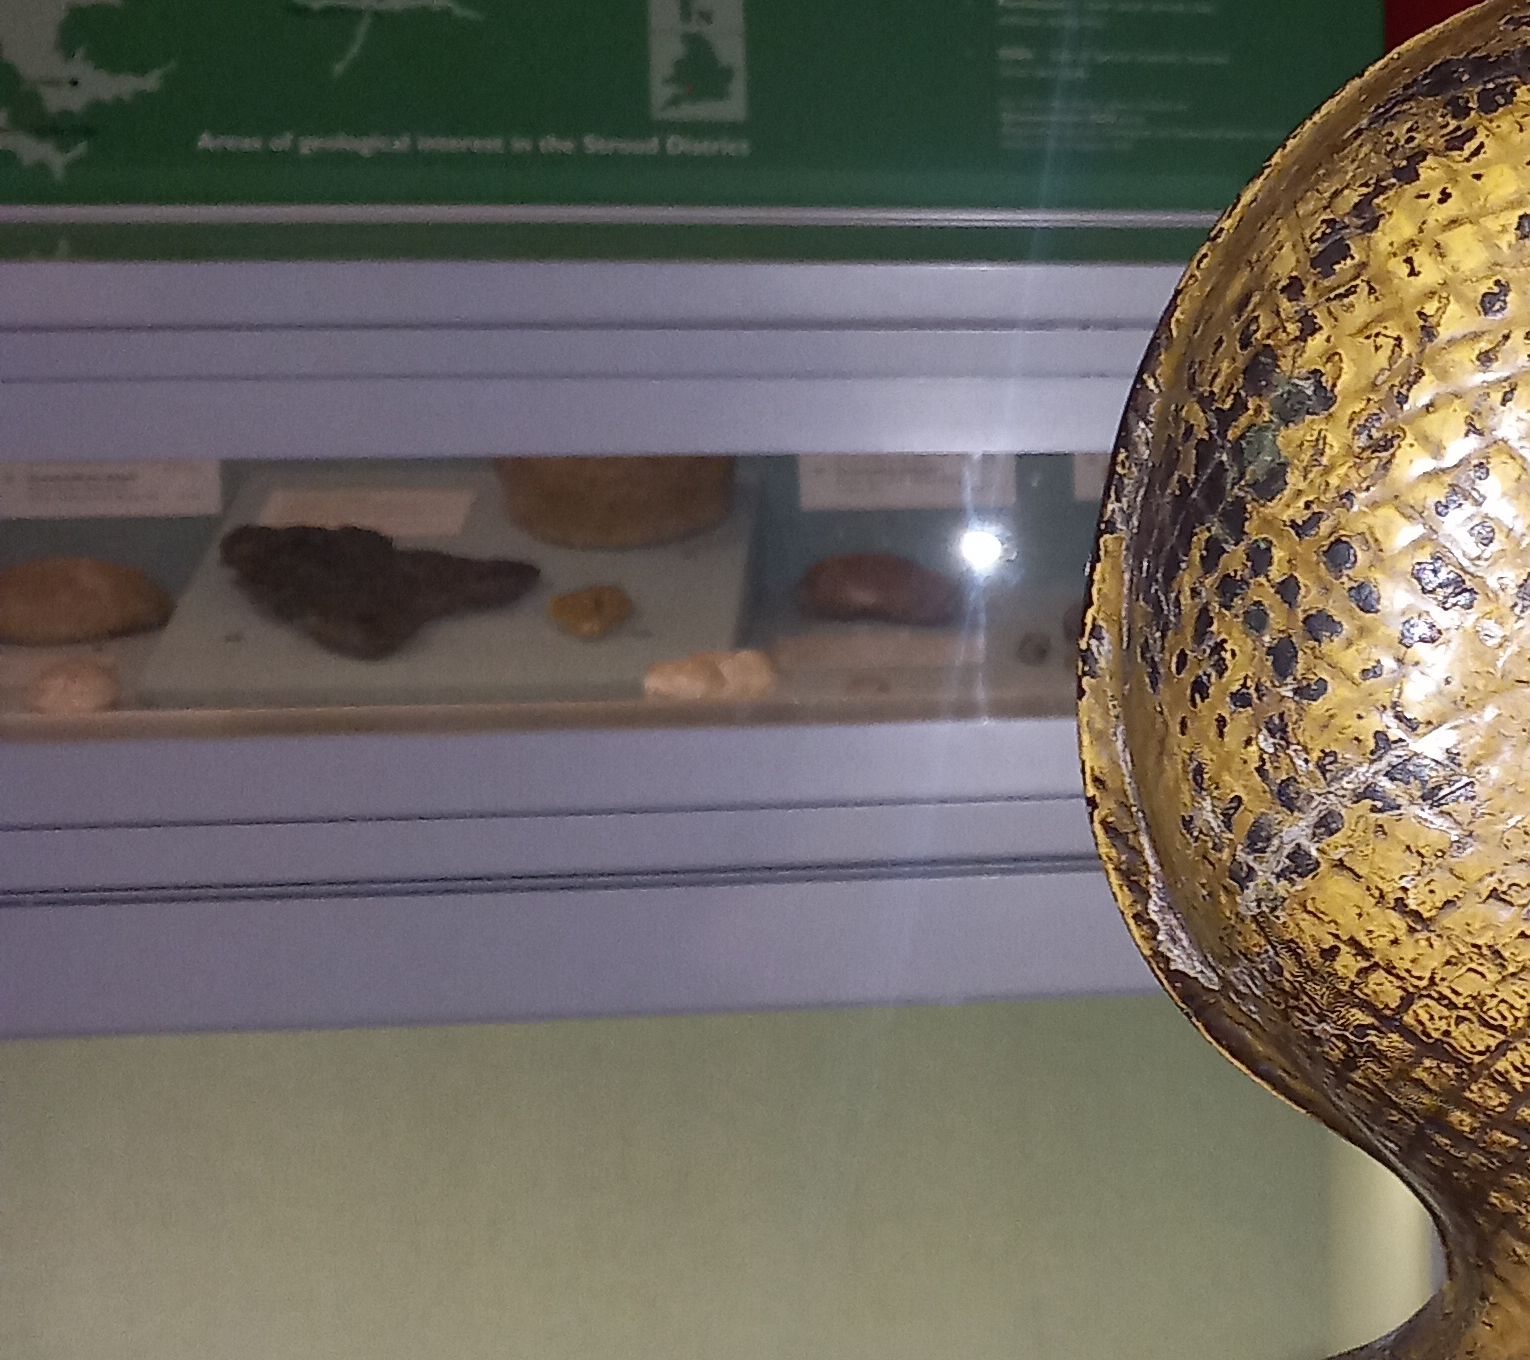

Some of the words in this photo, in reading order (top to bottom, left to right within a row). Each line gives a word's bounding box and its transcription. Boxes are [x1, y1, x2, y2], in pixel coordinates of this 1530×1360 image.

[269, 131, 294, 153] of
[510, 134, 533, 154] in
[539, 133, 576, 155] the
